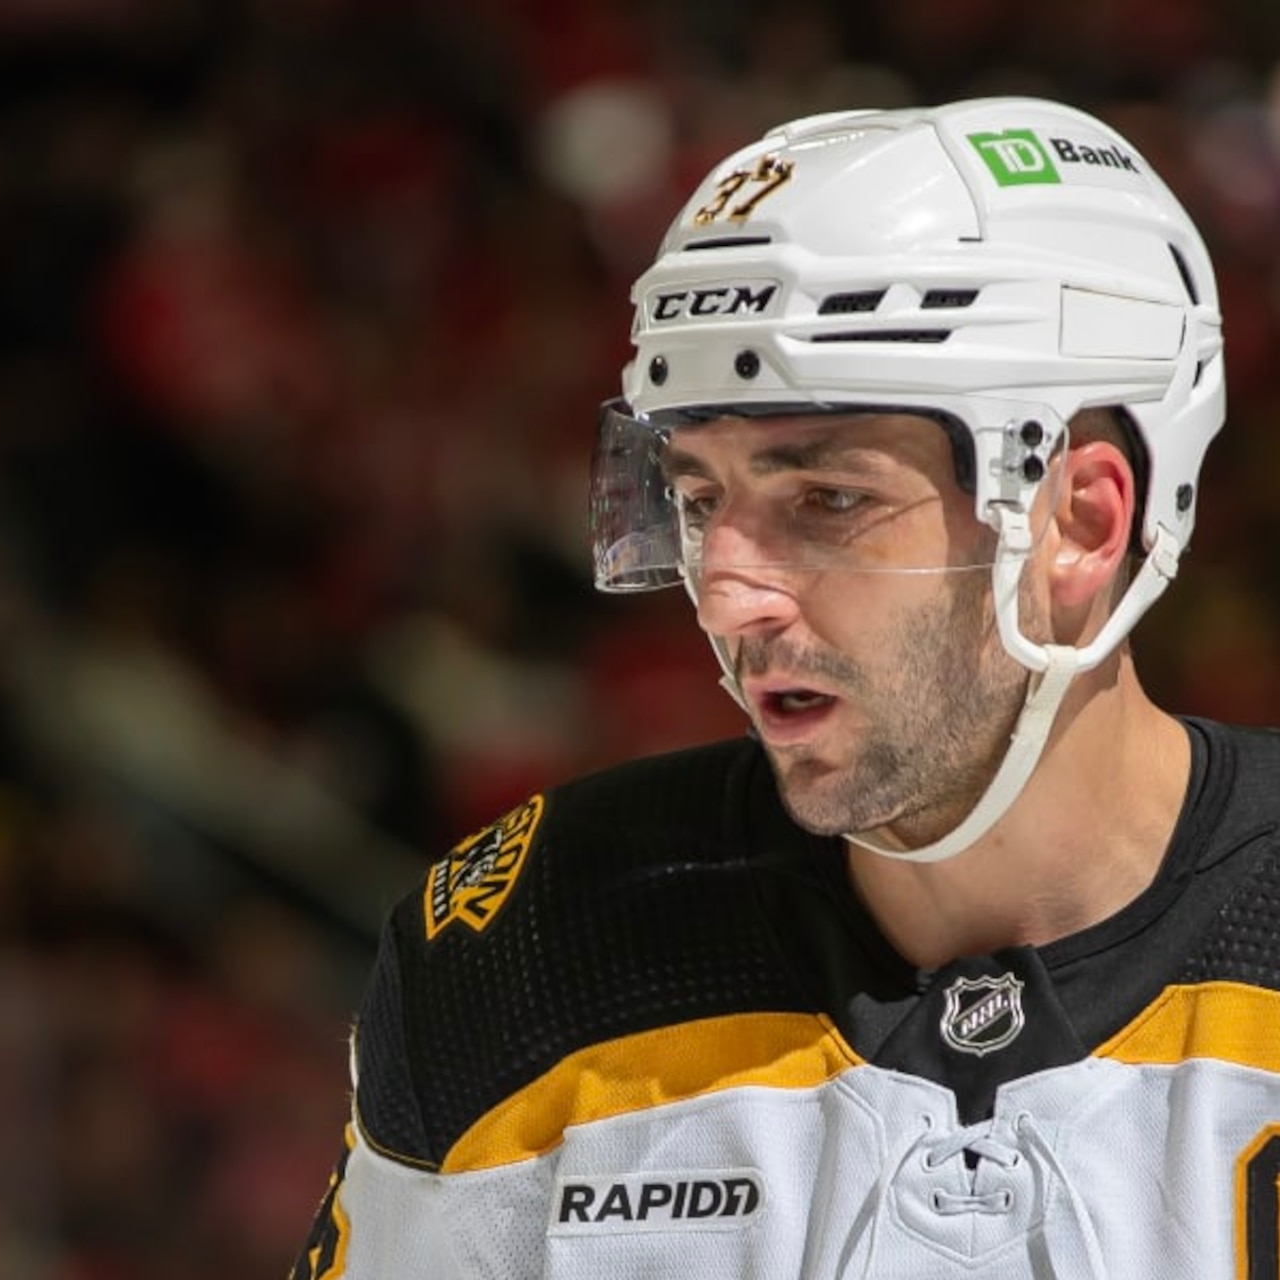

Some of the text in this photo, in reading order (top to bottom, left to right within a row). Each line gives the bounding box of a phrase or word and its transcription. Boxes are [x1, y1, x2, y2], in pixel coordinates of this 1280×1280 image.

[978, 137, 1140, 175] TD Bank
[694, 153, 797, 230] 37
[653, 285, 778, 321] CCM
[960, 993, 1009, 1037] NHL
